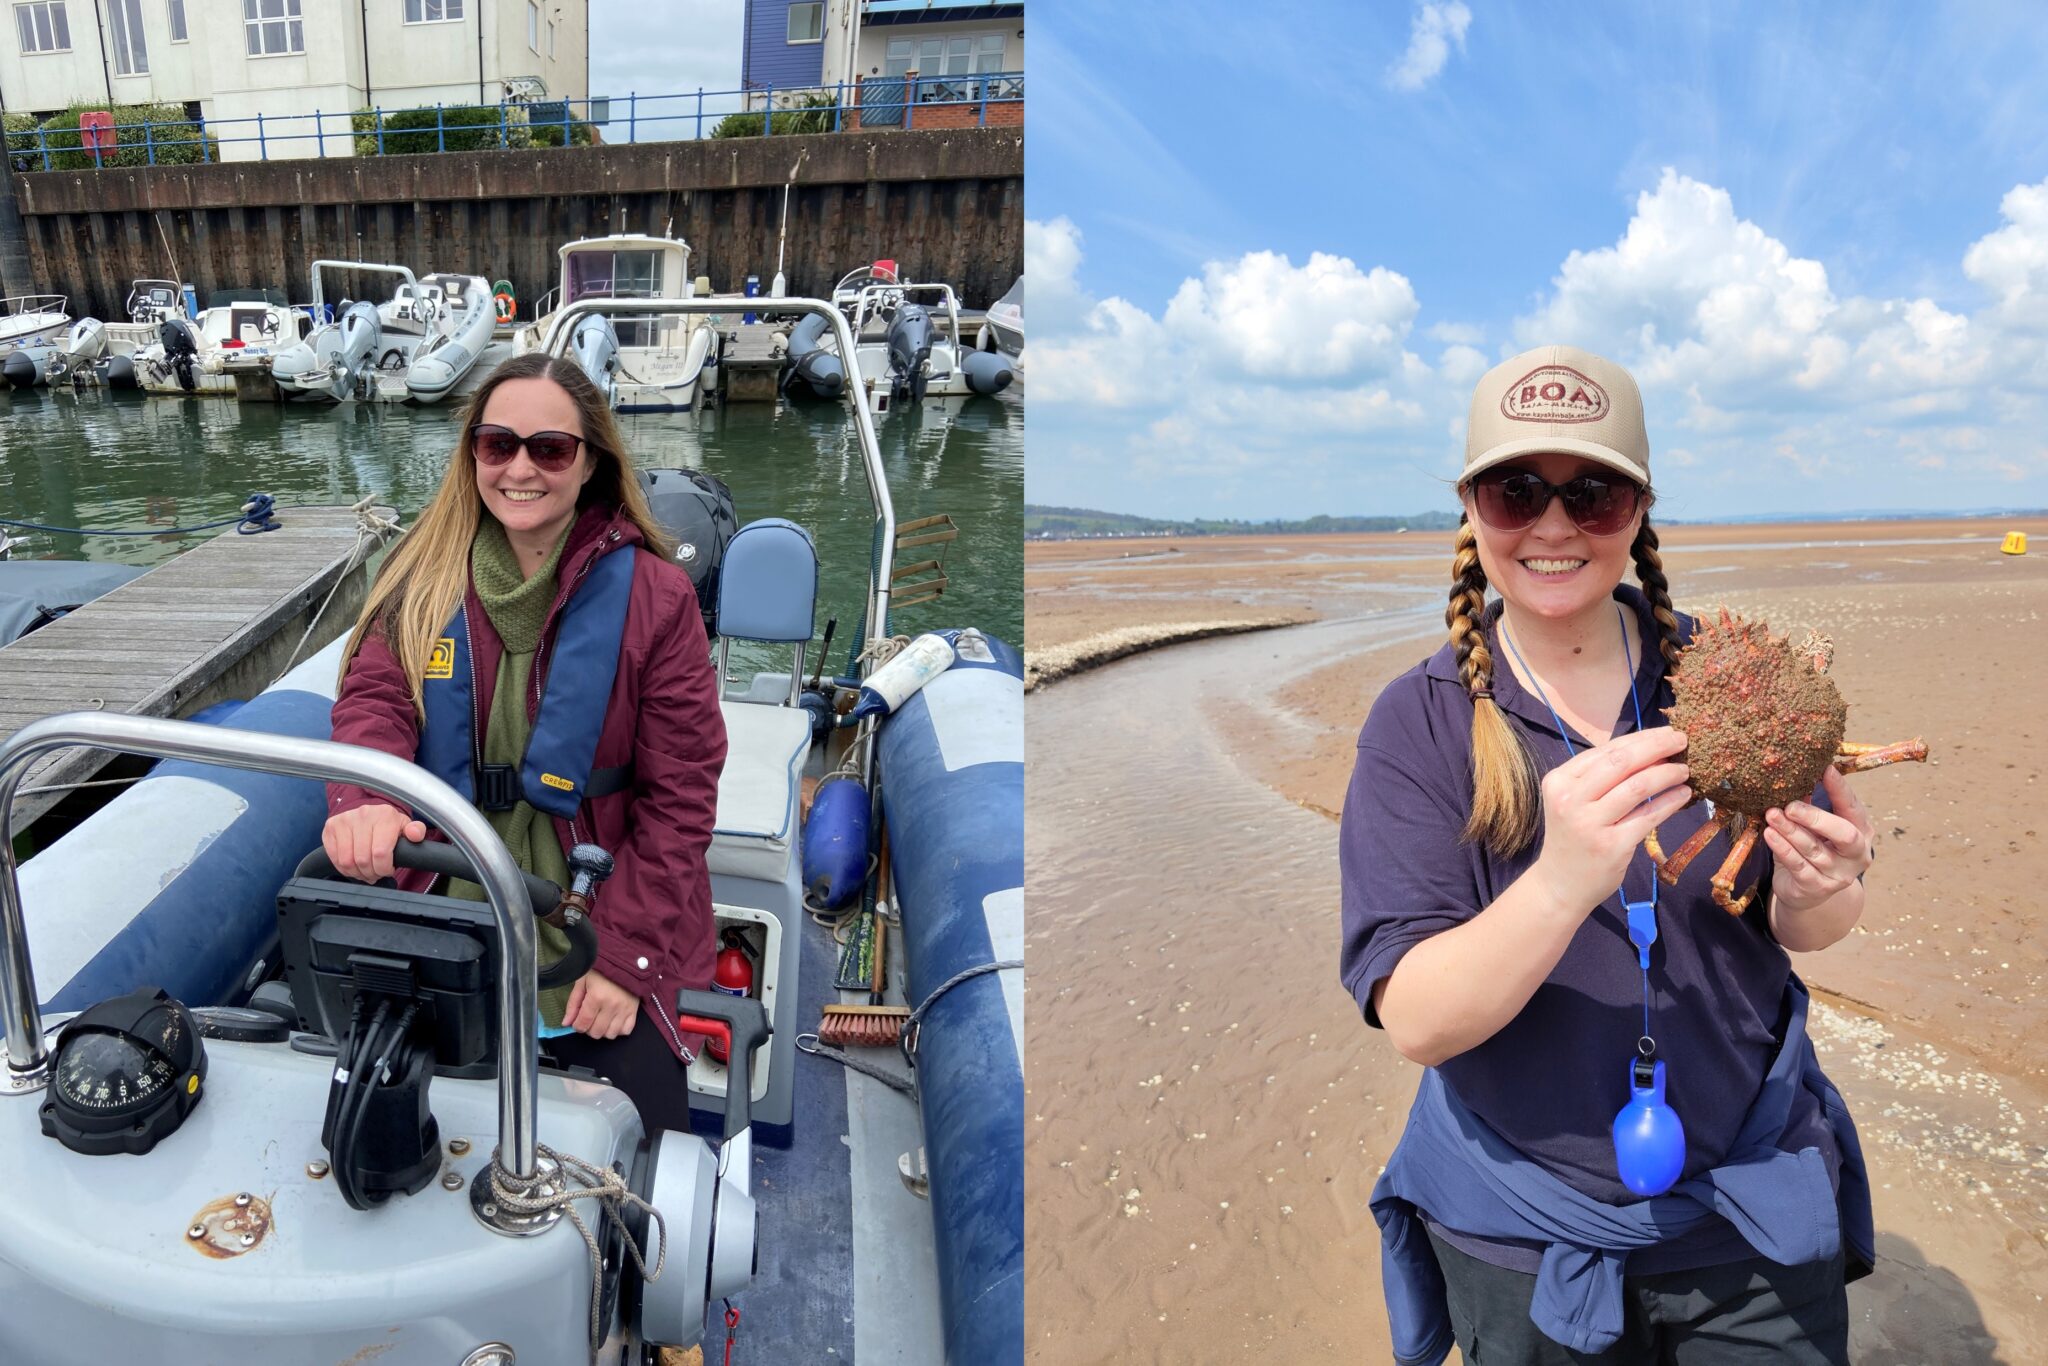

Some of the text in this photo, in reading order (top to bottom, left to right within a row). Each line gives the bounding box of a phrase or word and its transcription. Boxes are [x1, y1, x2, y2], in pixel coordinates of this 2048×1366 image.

[1520, 382, 1593, 406] BOA
[120, 1085, 127, 1097] S
[137, 1074, 152, 1089] 150
